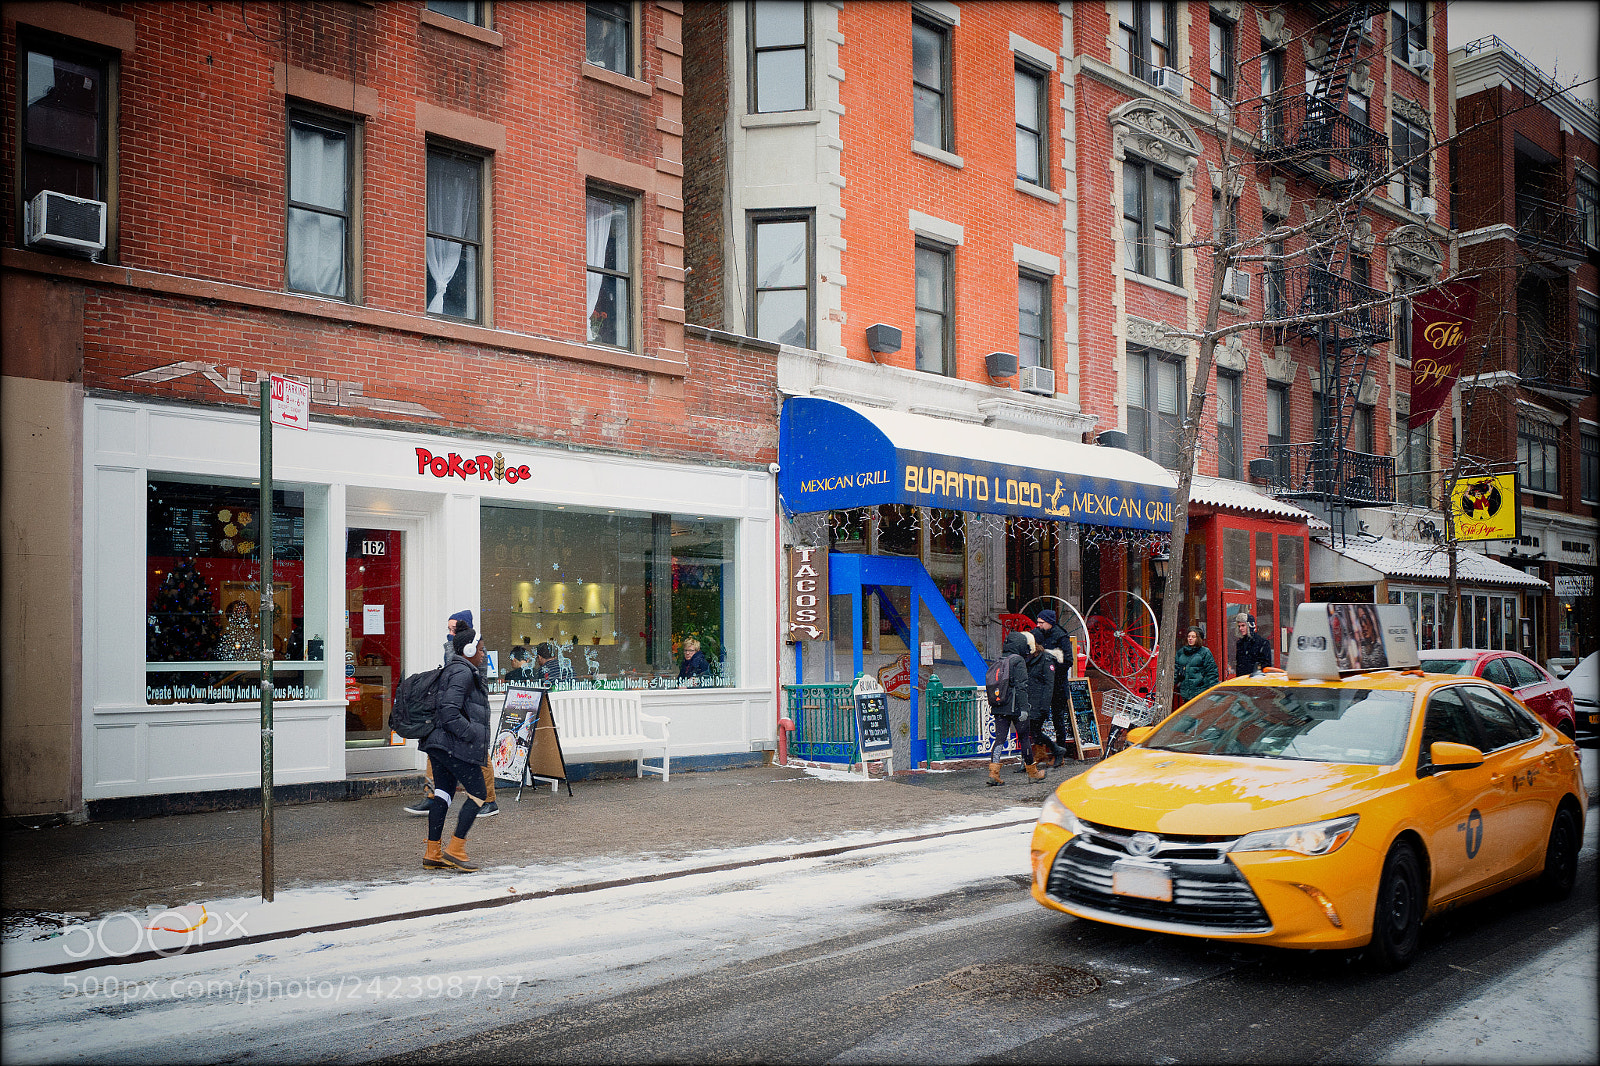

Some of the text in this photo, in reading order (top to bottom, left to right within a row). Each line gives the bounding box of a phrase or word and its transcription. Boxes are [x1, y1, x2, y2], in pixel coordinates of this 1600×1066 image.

[271, 379, 307, 398] NO PARKING
[800, 470, 890, 493] MEXICAN GRILL
[904, 465, 1042, 508] BURRITO LOCO
[1072, 491, 1174, 524] MEXICAN GRIL
[364, 541, 384, 555] 162
[794, 548, 819, 622] TACOS
[146, 685, 321, 702] Create Your Own Healthy And Nuious Poke Bowl
[554, 678, 571, 691] Sushi
[572, 678, 593, 691] Burrito
[603, 677, 627, 689] Zucchini
[627, 677, 649, 689] Noodles
[658, 676, 679, 690] Organic
[700, 675, 715, 688] Sushi
